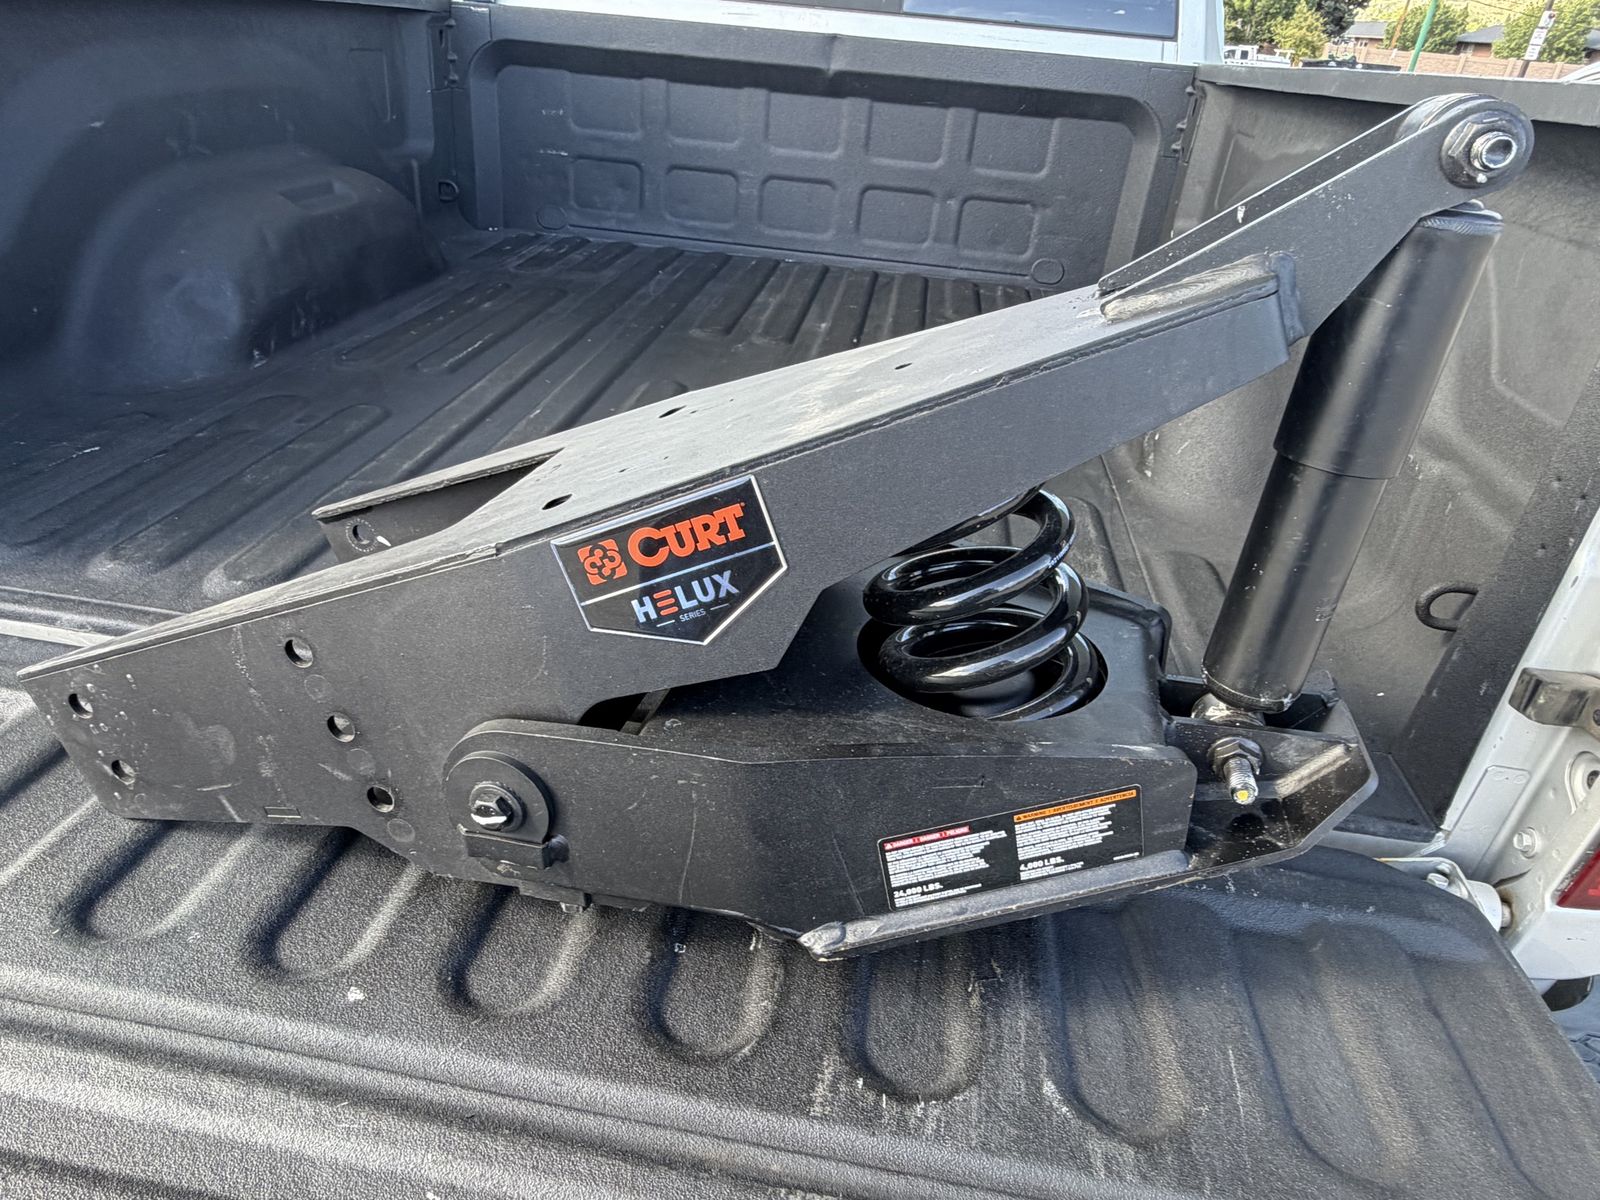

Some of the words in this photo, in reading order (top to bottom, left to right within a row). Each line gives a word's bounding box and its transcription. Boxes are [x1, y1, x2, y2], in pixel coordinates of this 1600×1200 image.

[627, 502, 747, 567] CURT
[631, 570, 740, 624] HELUX
[679, 608, 706, 622] SERIES
